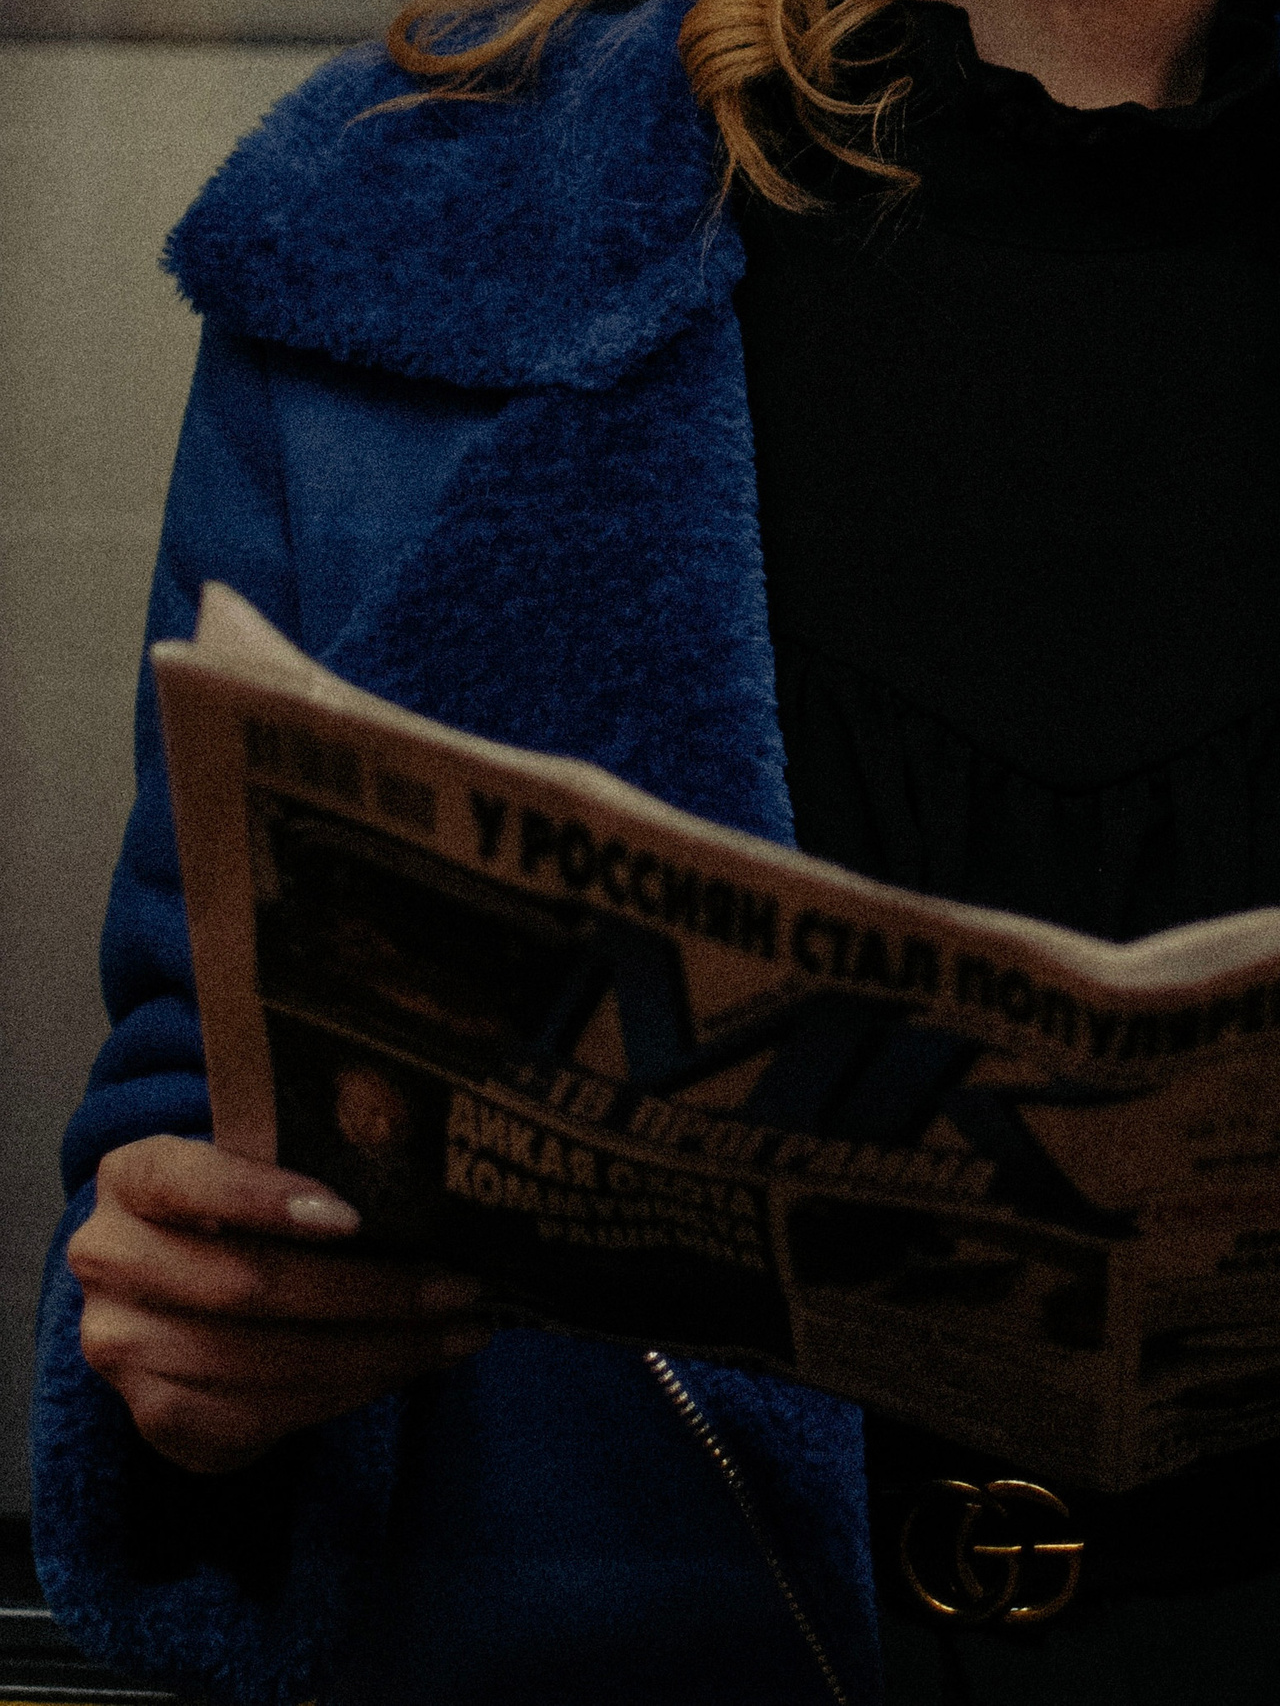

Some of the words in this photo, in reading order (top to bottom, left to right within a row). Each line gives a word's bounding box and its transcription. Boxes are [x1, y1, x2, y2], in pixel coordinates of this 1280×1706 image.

[471, 788, 506, 861] У
[519, 806, 779, 960] РОССИЯН
[793, 910, 940, 991] СТАЛ
[445, 1090, 598, 1190] ДИКАЯ
[625, 1094, 997, 1196] ПРОГРАММА
